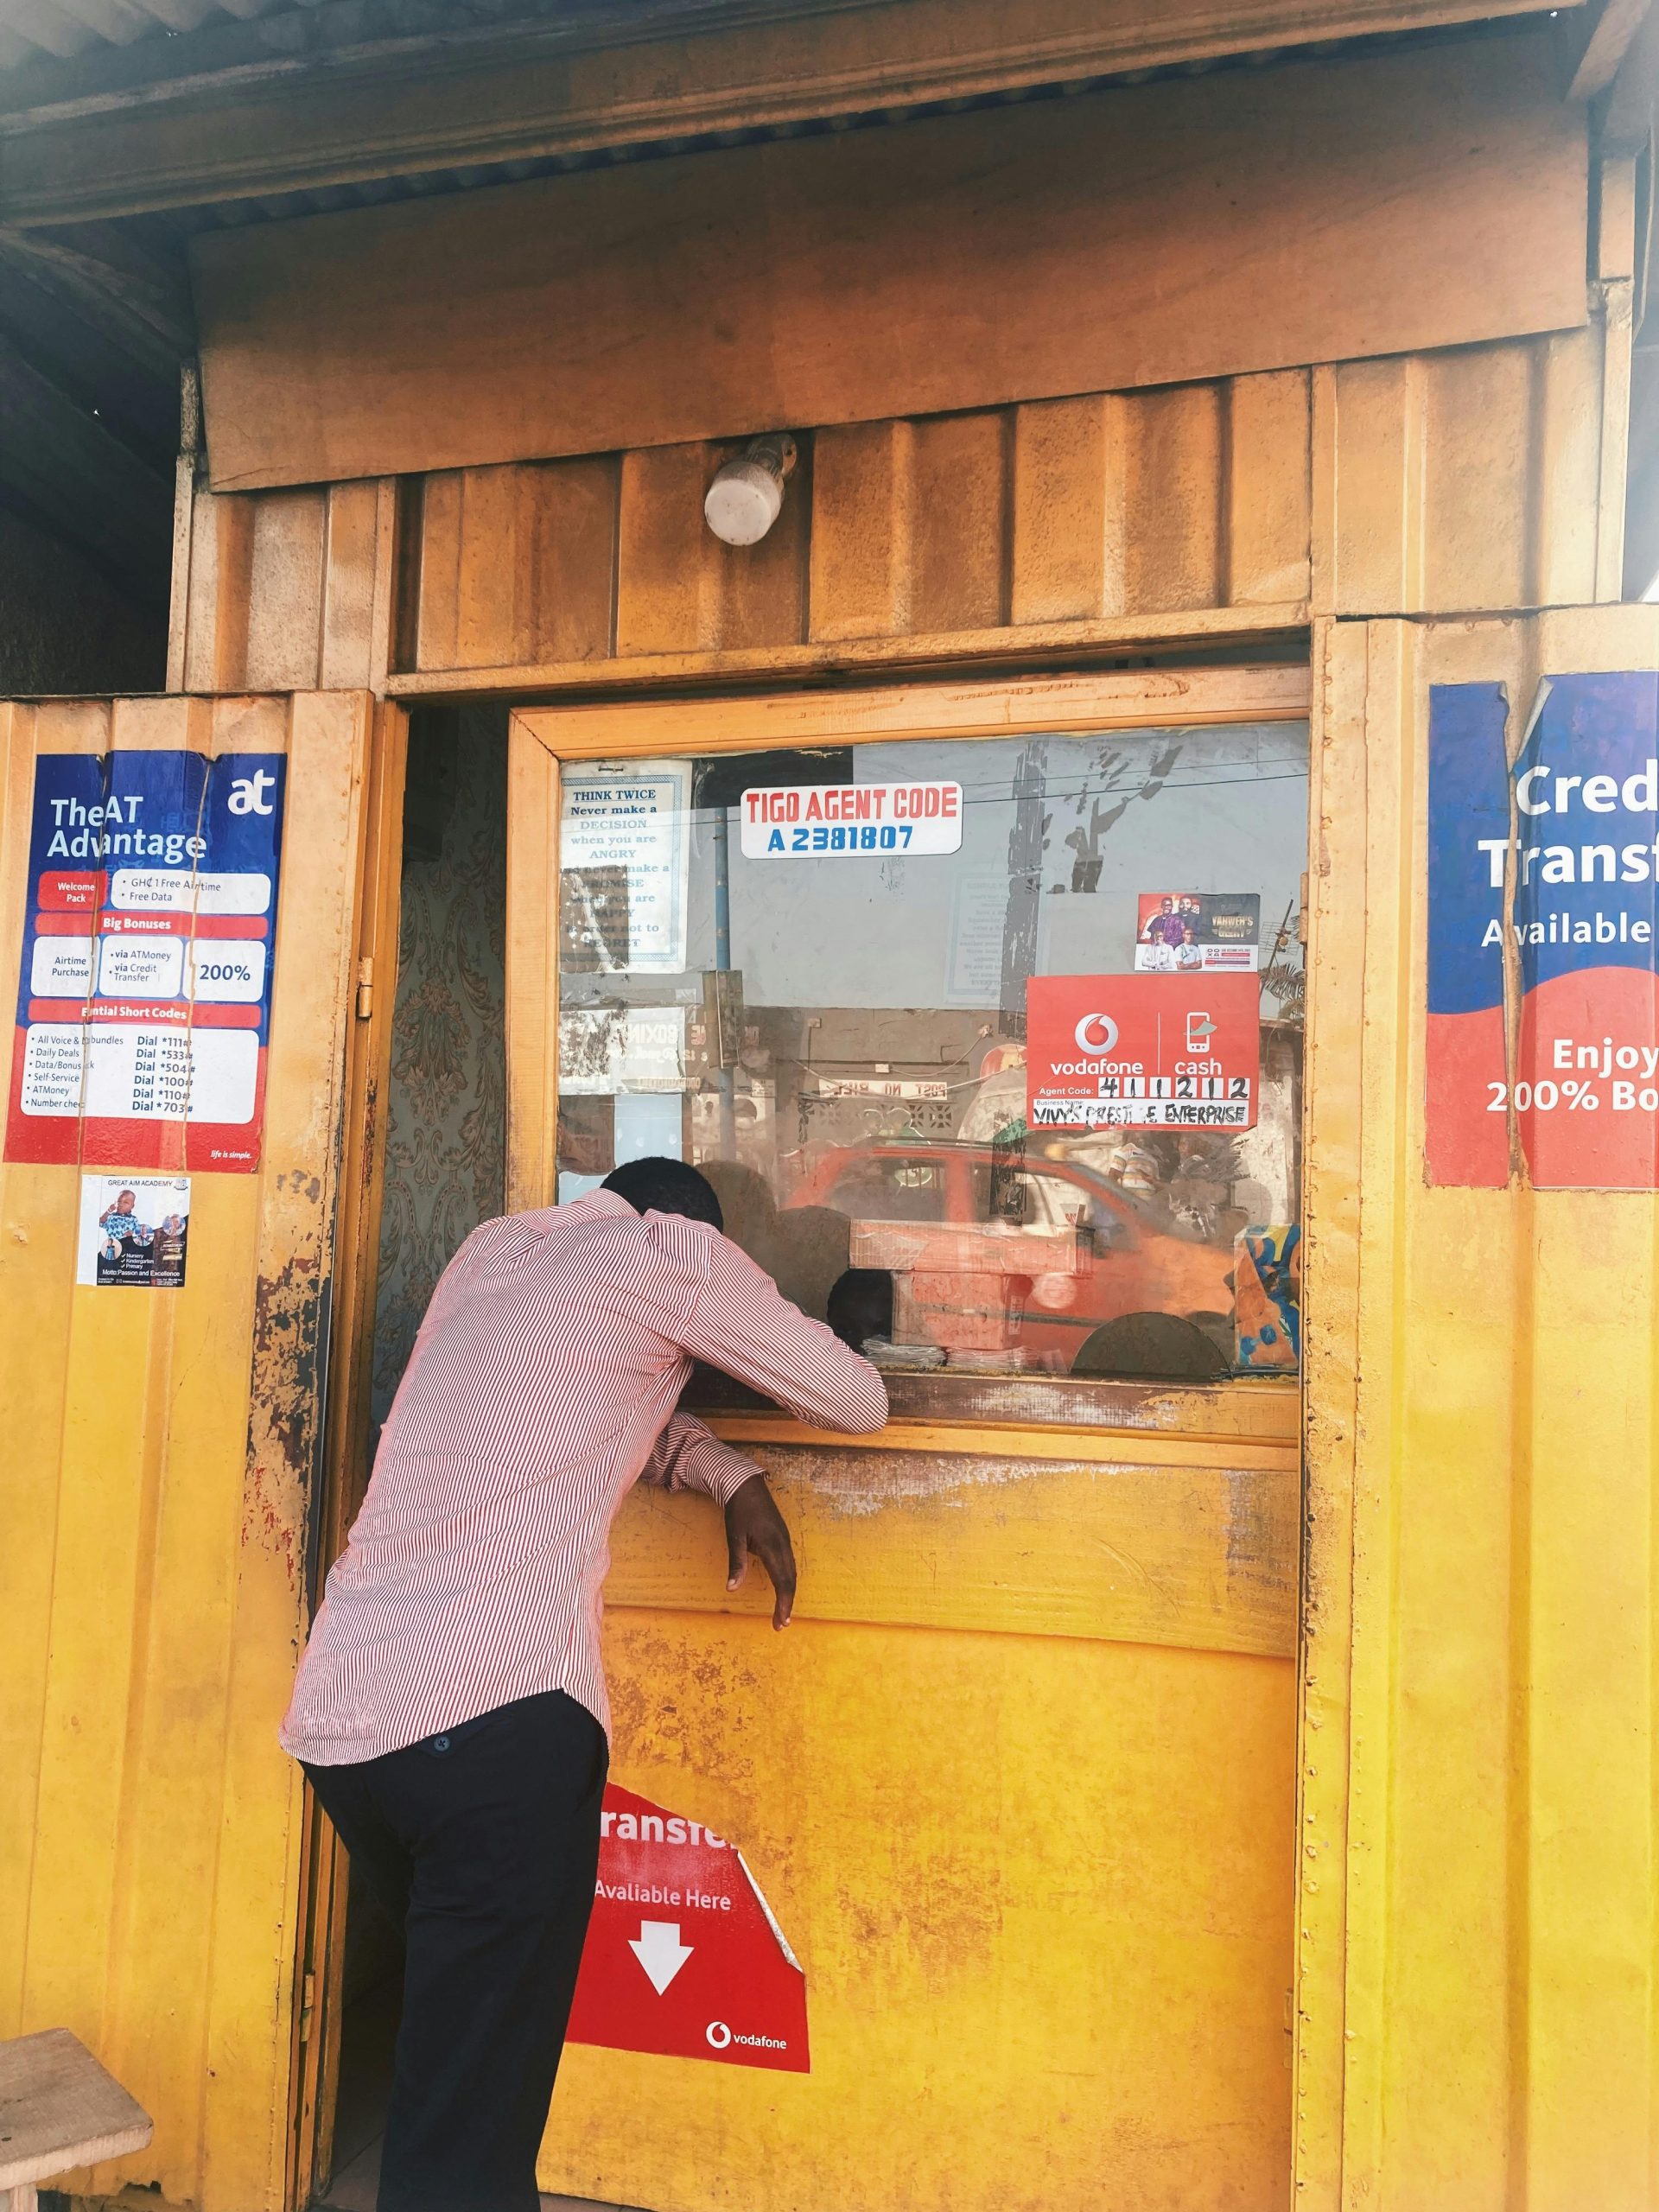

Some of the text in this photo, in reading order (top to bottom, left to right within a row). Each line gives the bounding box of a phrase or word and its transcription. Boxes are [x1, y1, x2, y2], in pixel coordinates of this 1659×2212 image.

[227, 769, 276, 815] at
[1516, 759, 1658, 816] Cred
[574, 790, 656, 801] THINK TWICE
[612, 805, 646, 814] make
[747, 787, 957, 823] TIGO AGENT CODE
[50, 796, 143, 827] The AT
[580, 820, 646, 830] DECISION
[47, 829, 207, 864] Advantage
[571, 836, 604, 844] when
[608, 837, 631, 848] you
[589, 849, 637, 859] ANGRY
[57, 882, 96, 892] Welcome
[162, 880, 181, 888] Free
[183, 880, 221, 892] Airtime
[67, 893, 86, 903] Pack
[130, 893, 173, 901] Free Data
[103, 918, 171, 931] Big Bonuses
[646, 924, 659, 932] to
[1481, 912, 1651, 947] Available
[54, 957, 86, 965] Airtime
[130, 951, 171, 962] ATMoney
[52, 968, 89, 977] Purchase
[114, 964, 157, 973] via Credit
[200, 965, 251, 982] 200%
[114, 973, 149, 982] Transfer
[119, 1007, 149, 1018] Short
[152, 1007, 188, 1020] Codes
[38, 1036, 49, 1045] All
[51, 1036, 73, 1045] Voice
[91, 1035, 124, 1045] bundles
[137, 1036, 157, 1046] Dial
[36, 1048, 79, 1058] Daily Deals
[137, 1049, 156, 1058] Dial
[1554, 1037, 1659, 1079] Enjoy
[135, 1062, 156, 1071] Dial
[1051, 1058, 1222, 1076] vodafone cash
[34, 1072, 79, 1082] Self-Service
[134, 1075, 154, 1085] Dial
[33, 1085, 69, 1096] ATMoney
[133, 1089, 153, 1098] Dial
[1039, 1087, 1065, 1096] Agent
[1486, 1080, 1599, 1111] 200%
[31, 1098, 62, 1107] Number
[132, 1102, 153, 1112] Dial
[210, 1150, 222, 1160] life
[222, 1150, 228, 1159] is
[594, 1879, 732, 1910] Avaliable Here
[734, 2033, 787, 2050] vodafone
